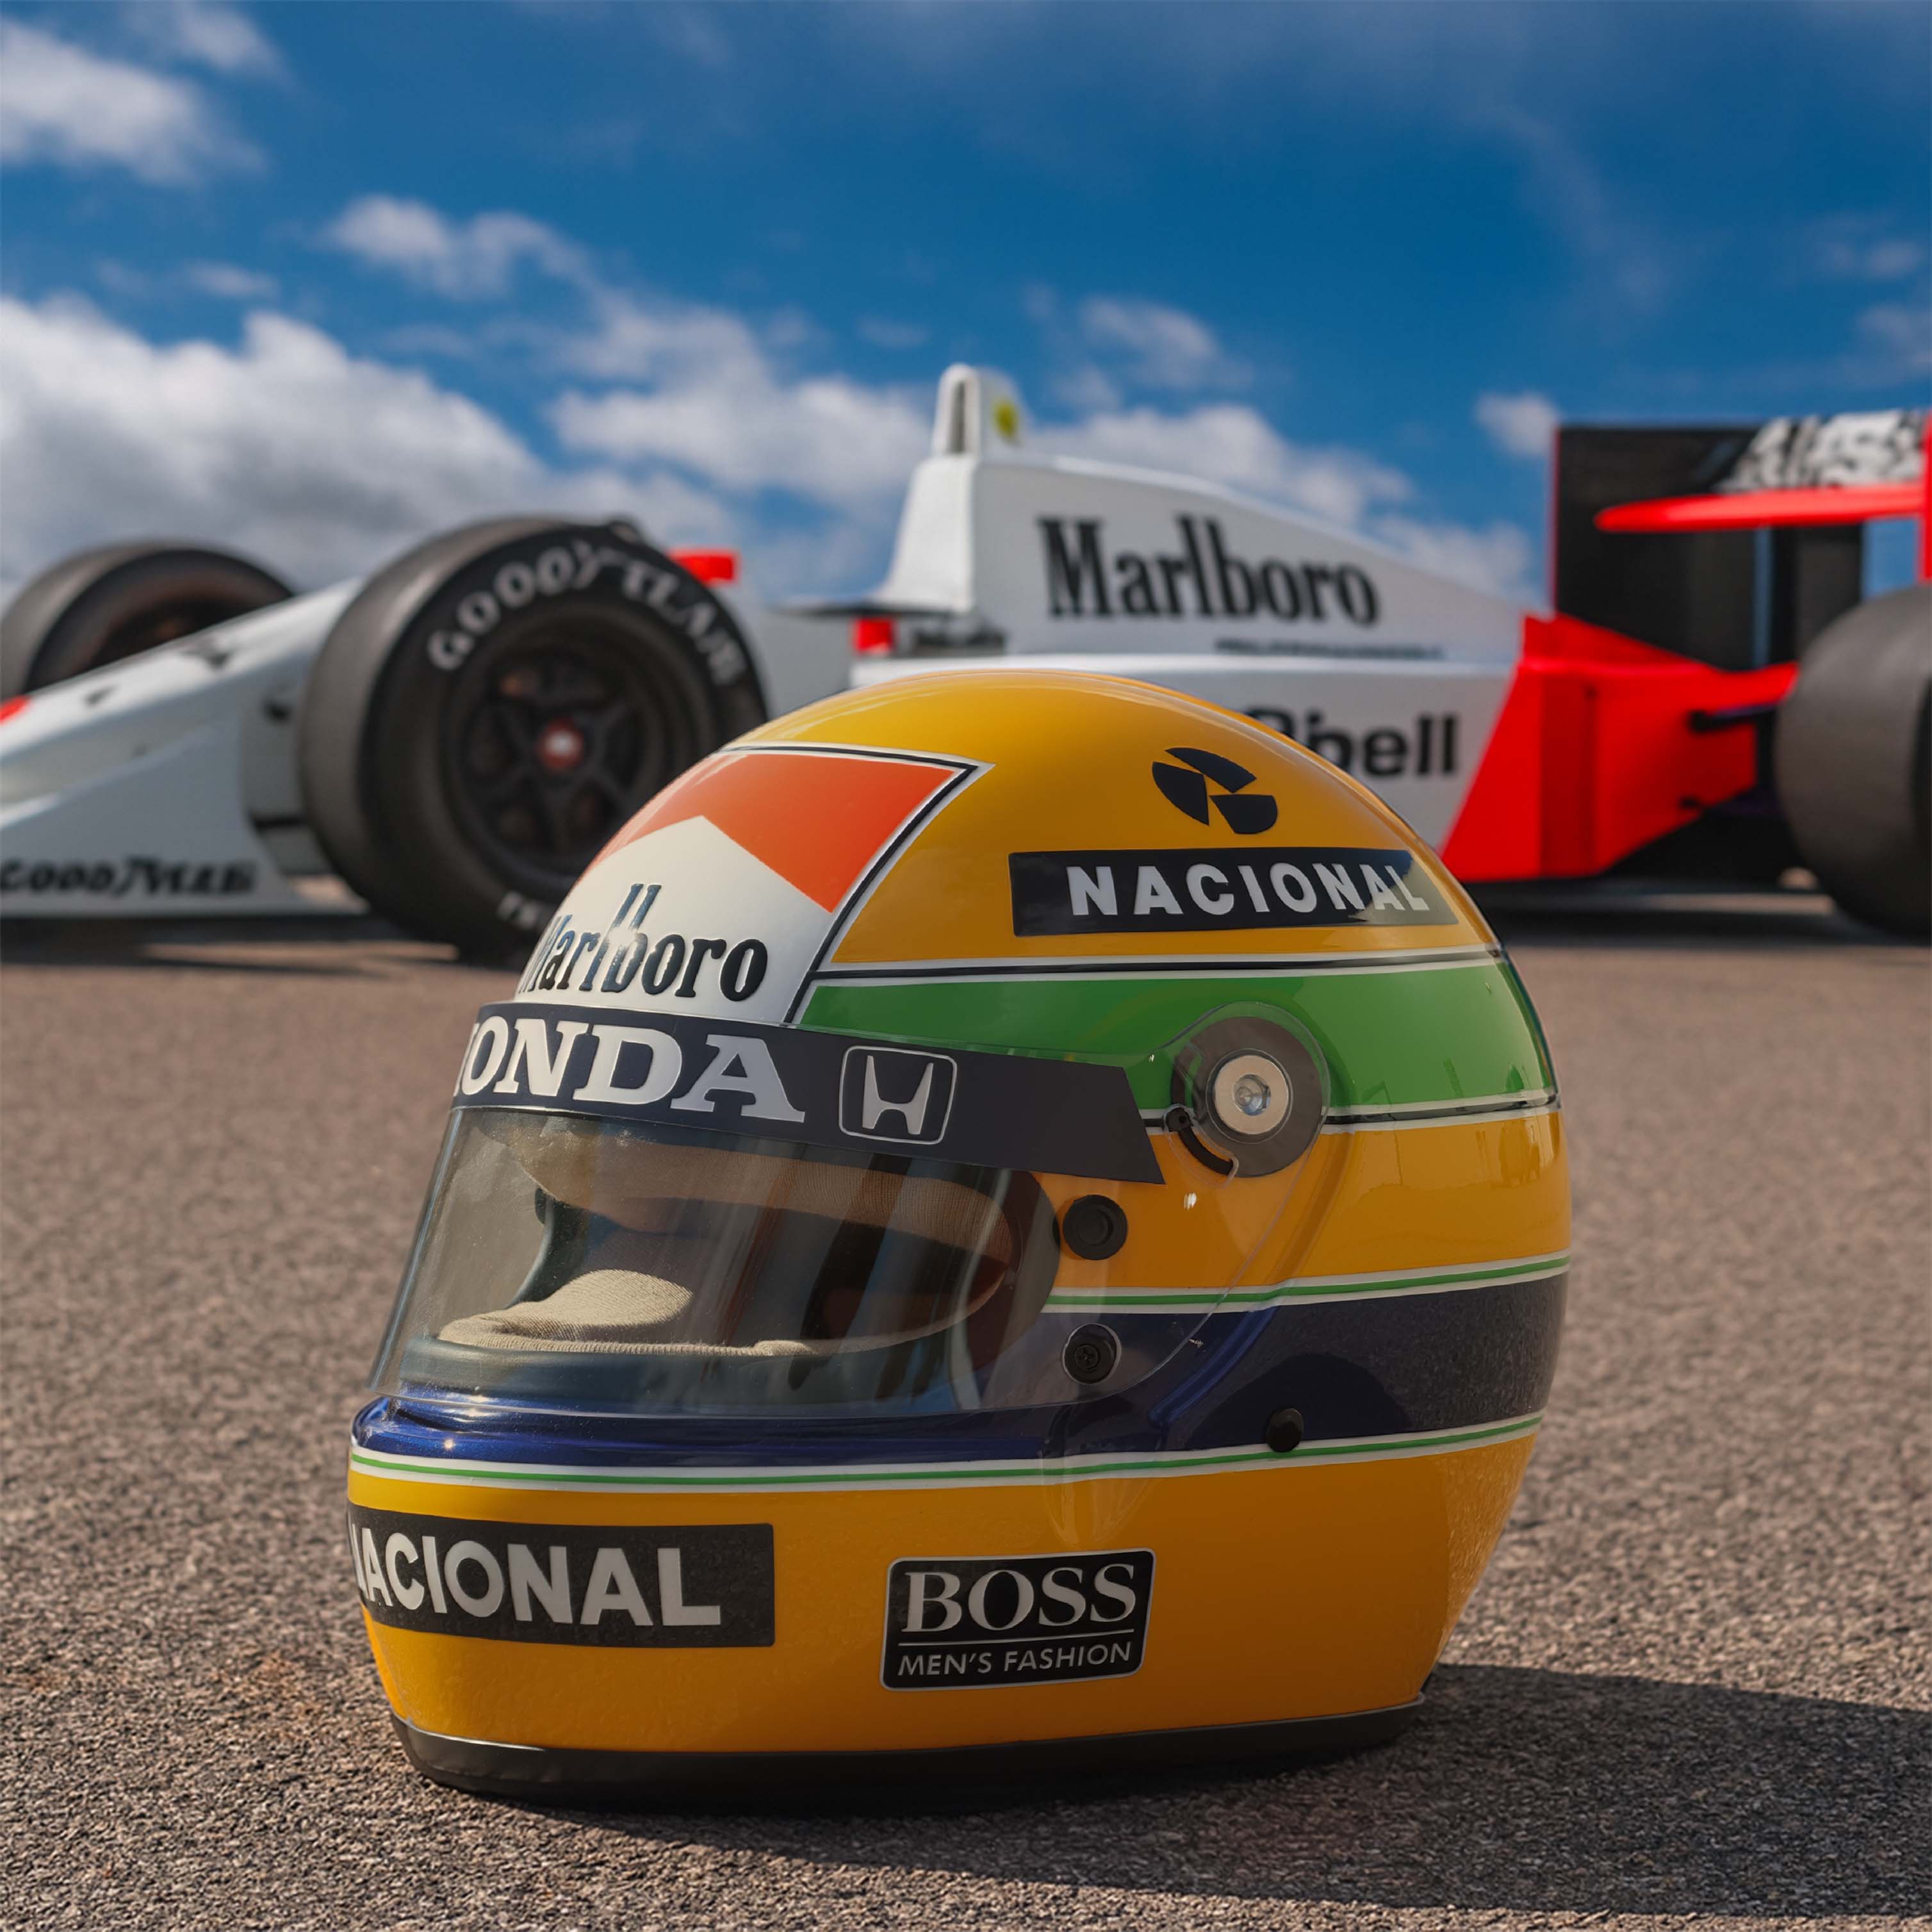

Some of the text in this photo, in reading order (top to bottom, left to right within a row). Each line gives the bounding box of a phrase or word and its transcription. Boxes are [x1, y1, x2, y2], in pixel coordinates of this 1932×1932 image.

[1037, 512, 1380, 626] Marlboro
[1066, 862, 1430, 915] NACIONAL
[518, 883, 768, 1001] Marlboro
[452, 1015, 806, 1123] ONDA
[901, 1563, 1136, 1633] BOSS
[897, 1641, 1132, 1676] MEN'S FASHION
